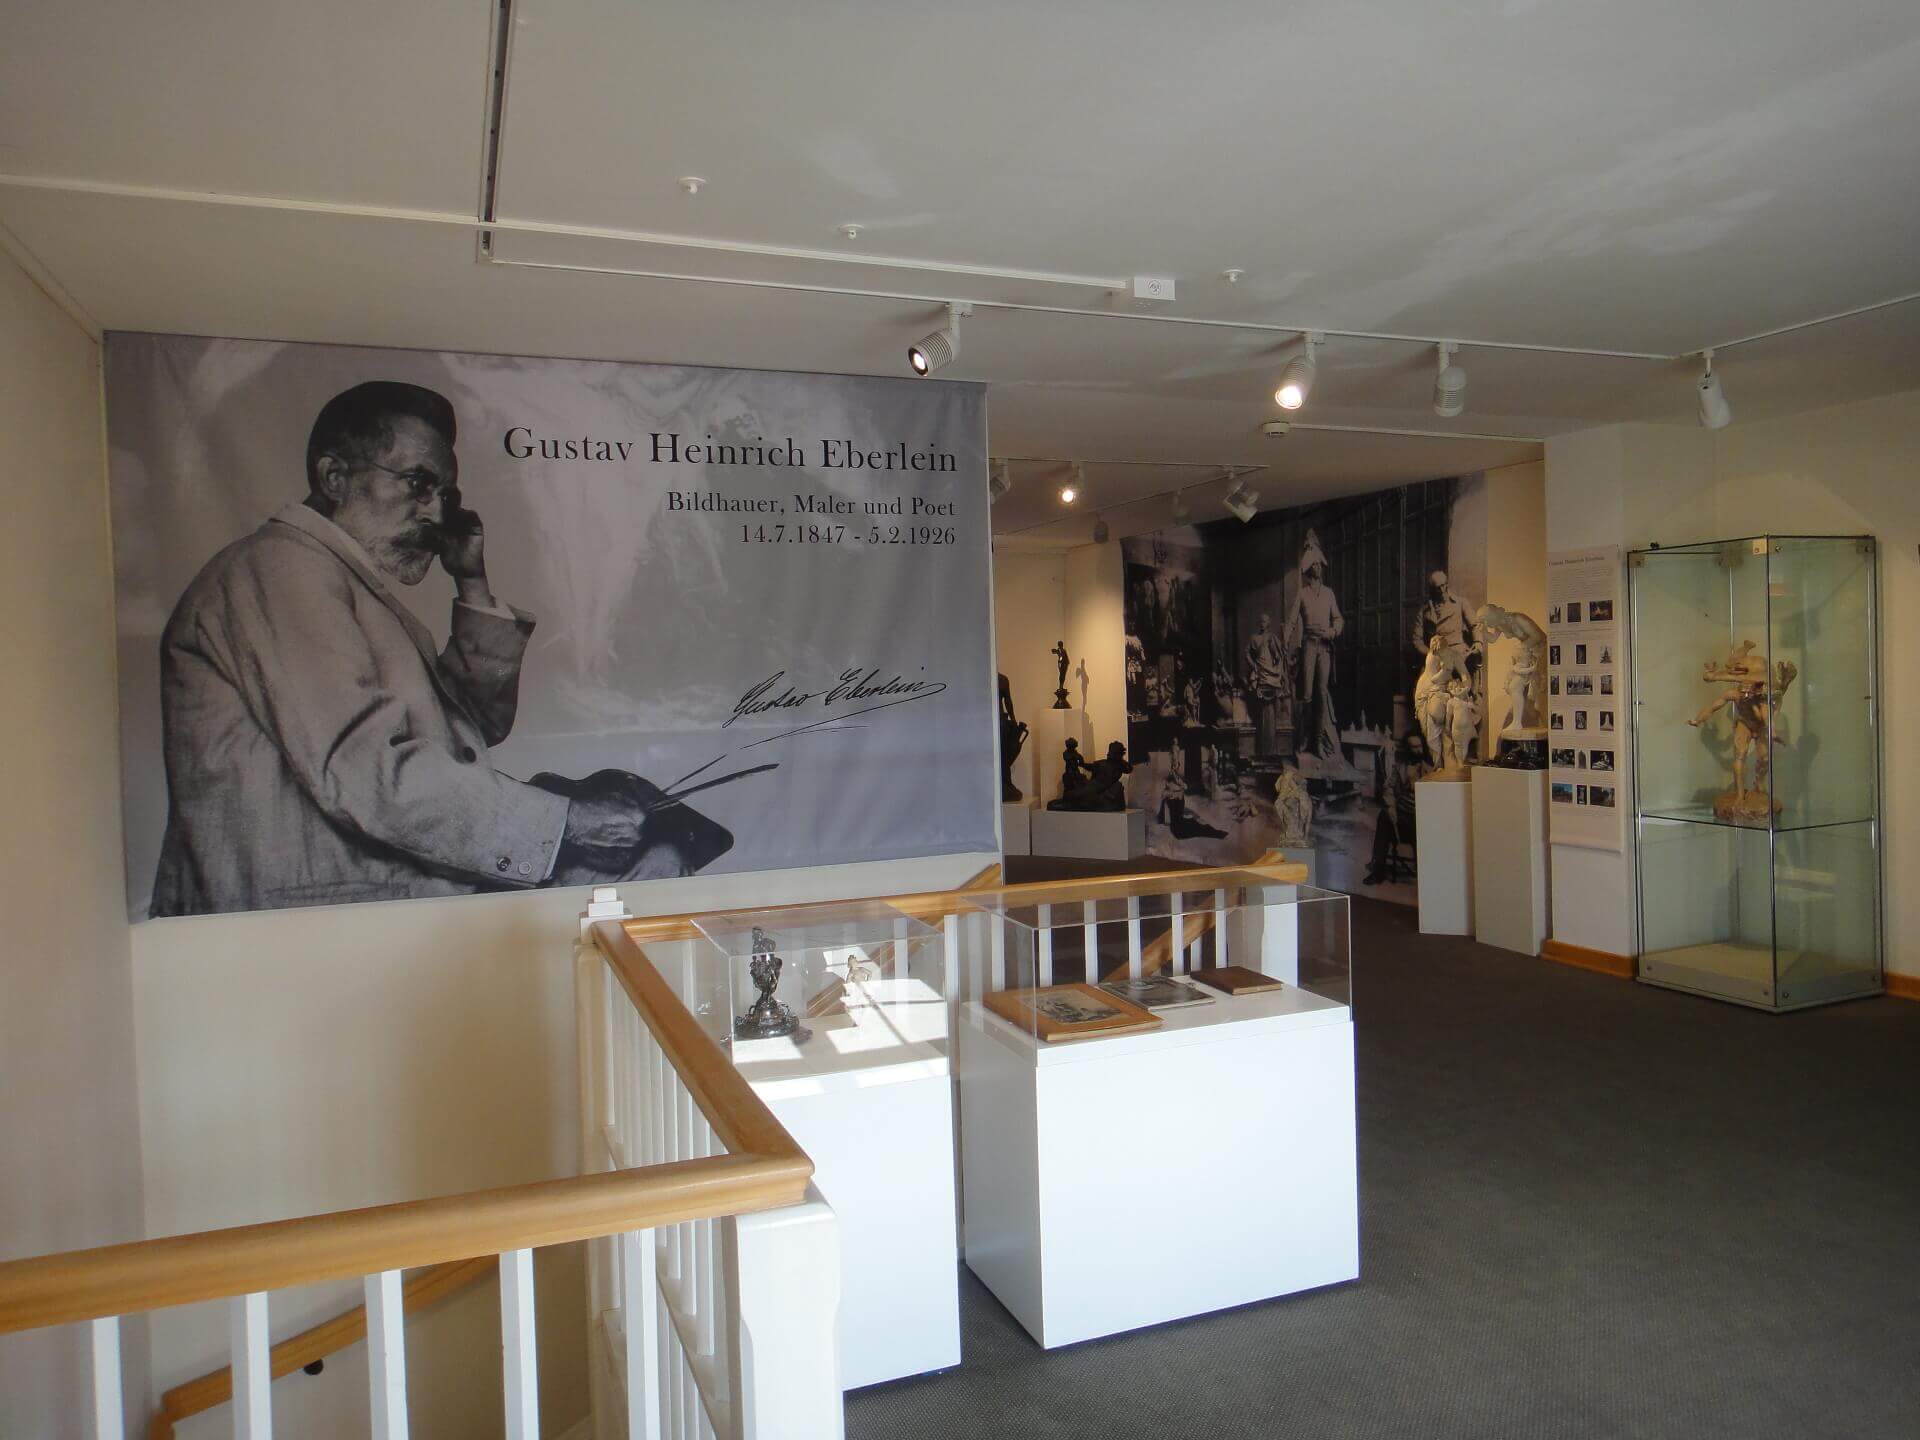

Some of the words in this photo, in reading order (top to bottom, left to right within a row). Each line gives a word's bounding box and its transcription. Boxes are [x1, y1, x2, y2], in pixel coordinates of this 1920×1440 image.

[503, 426, 634, 461] Gustav
[648, 432, 806, 467] Heinrich
[819, 439, 958, 472] Eberlein
[666, 491, 786, 515] Bildhauer,
[794, 494, 856, 514] Maler
[863, 496, 903, 515] und
[911, 497, 956, 516] Poet
[741, 524, 845, 544] 14.7.1847
[868, 526, 956, 545] 5.2.1926
